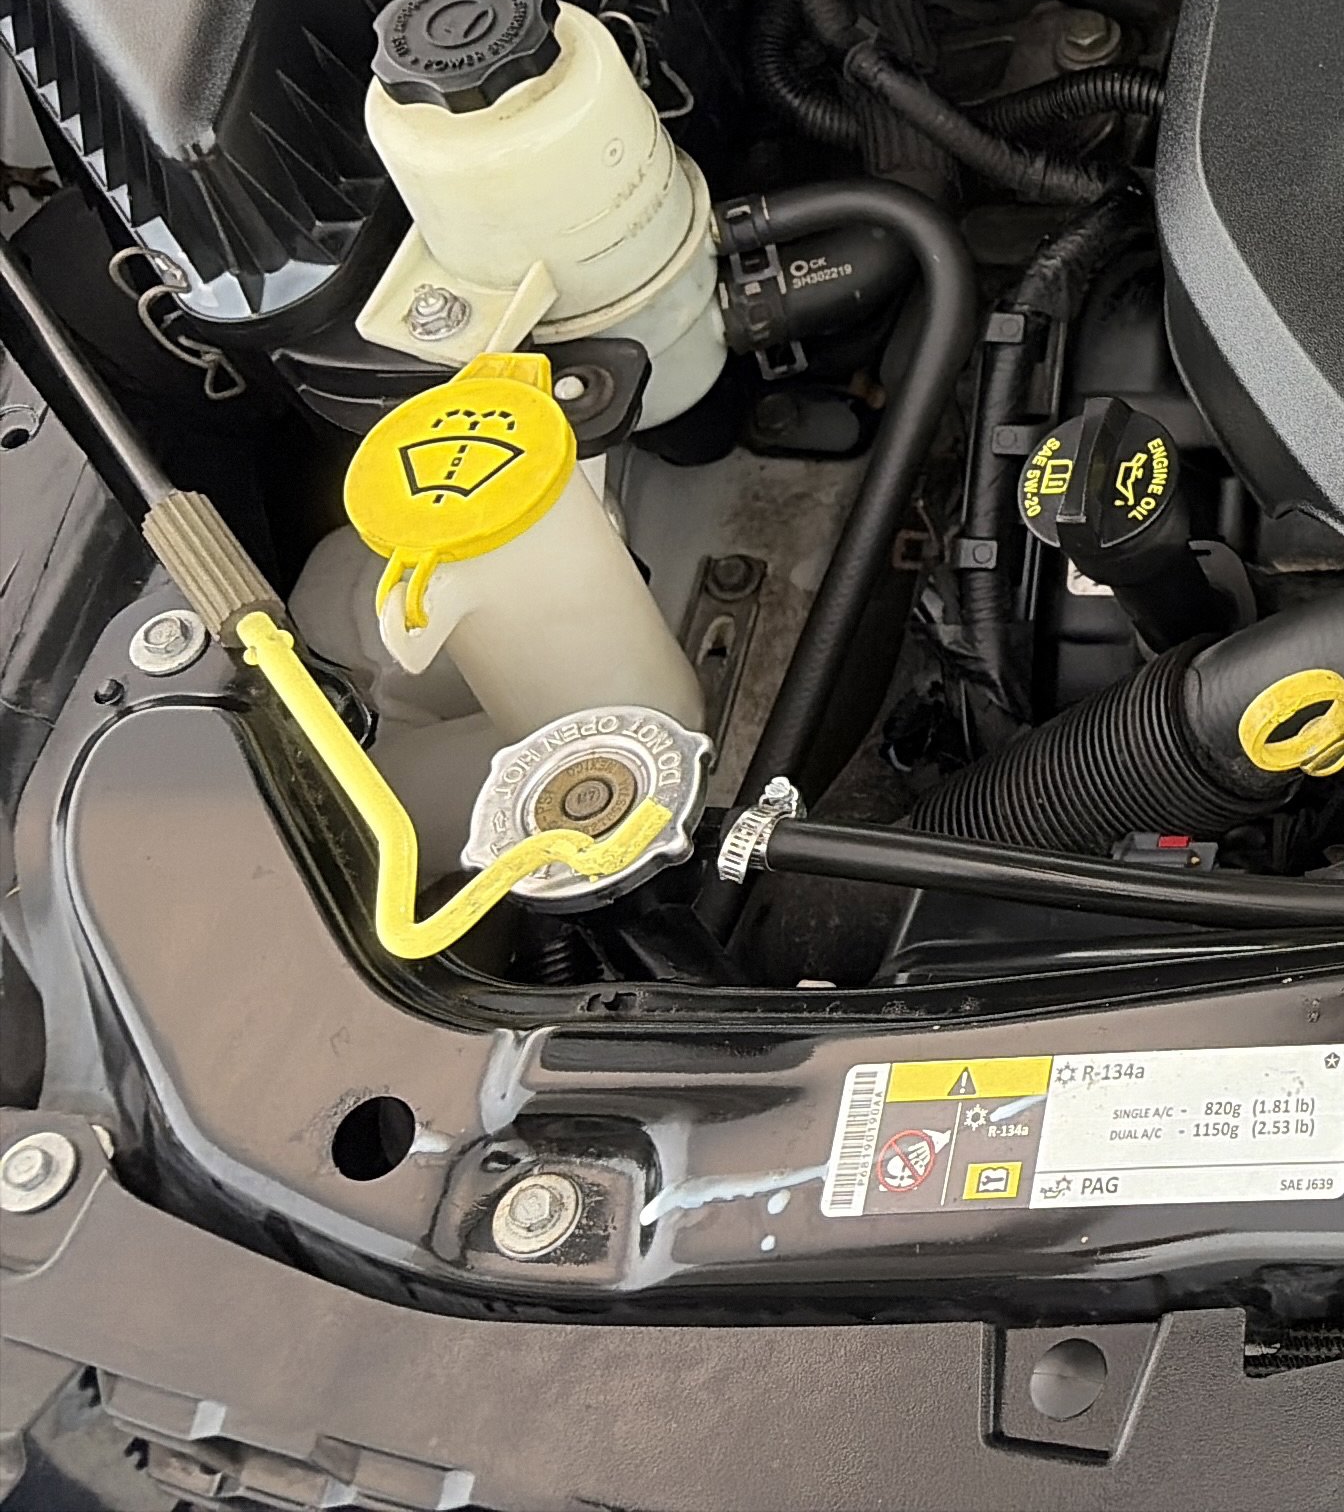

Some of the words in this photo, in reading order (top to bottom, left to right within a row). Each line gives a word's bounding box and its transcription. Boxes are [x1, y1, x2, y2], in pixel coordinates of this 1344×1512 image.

[424, 52, 486, 72] POWER
[1032, 437, 1061, 467] SAE
[1147, 437, 1169, 496] ENGINE
[1024, 469, 1042, 518] 5W-20
[1128, 498, 1156, 521] OIL
[544, 715, 619, 751] OPEN
[621, 719, 676, 755] NOT
[493, 748, 541, 800] HOT
[656, 750, 682, 788] DO
[1082, 1063, 1145, 1082] R-134a
[1113, 1108, 1151, 1120] SINGLE
[1153, 1106, 1174, 1118] A/C
[1204, 1101, 1242, 1118] 820g
[1252, 1098, 1290, 1117] (1.81
[1295, 1097, 1316, 1115] lb)
[856, 1090, 883, 1186] P68190190AA
[986, 1123, 1030, 1139] R-134a
[1109, 1130, 1139, 1141] DUAL
[1141, 1127, 1163, 1139] A/C
[1193, 1122, 1240, 1139] 1150g
[1251, 1120, 1290, 1138] (2.53
[1294, 1119, 1315, 1137] lb)
[1080, 1176, 1120, 1195] PAG
[1279, 1179, 1303, 1191] SAE
[1305, 1178, 1334, 1190] J639
